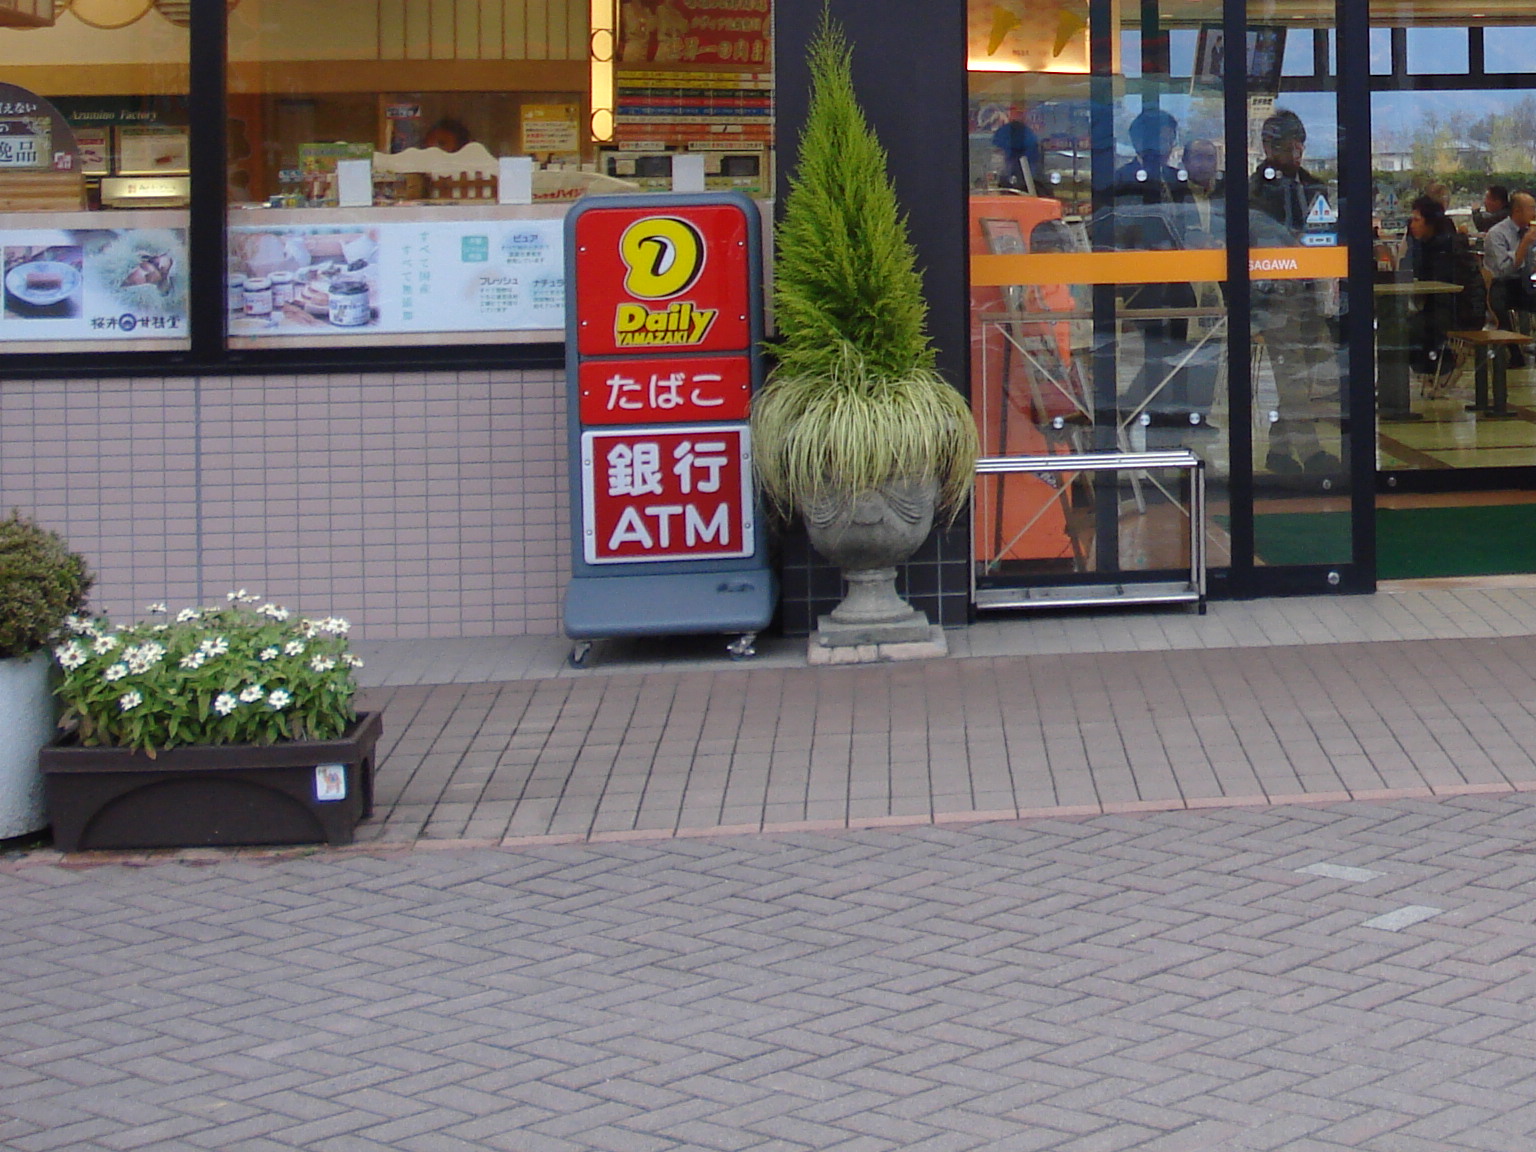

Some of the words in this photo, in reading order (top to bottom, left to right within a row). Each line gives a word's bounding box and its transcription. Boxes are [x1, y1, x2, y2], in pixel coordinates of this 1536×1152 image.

[71, 110, 115, 120] Azumino
[119, 109, 157, 122] Factory
[513, 234, 539, 243] ピュア
[479, 277, 518, 286] フレッシュ
[532, 279, 566, 288] ナチュラ
[617, 302, 717, 344] Daily
[617, 331, 690, 346] YAMAZAKI
[606, 372, 725, 410] たばこ
[606, 440, 728, 496] 銀行
[608, 503, 729, 550] ATM
